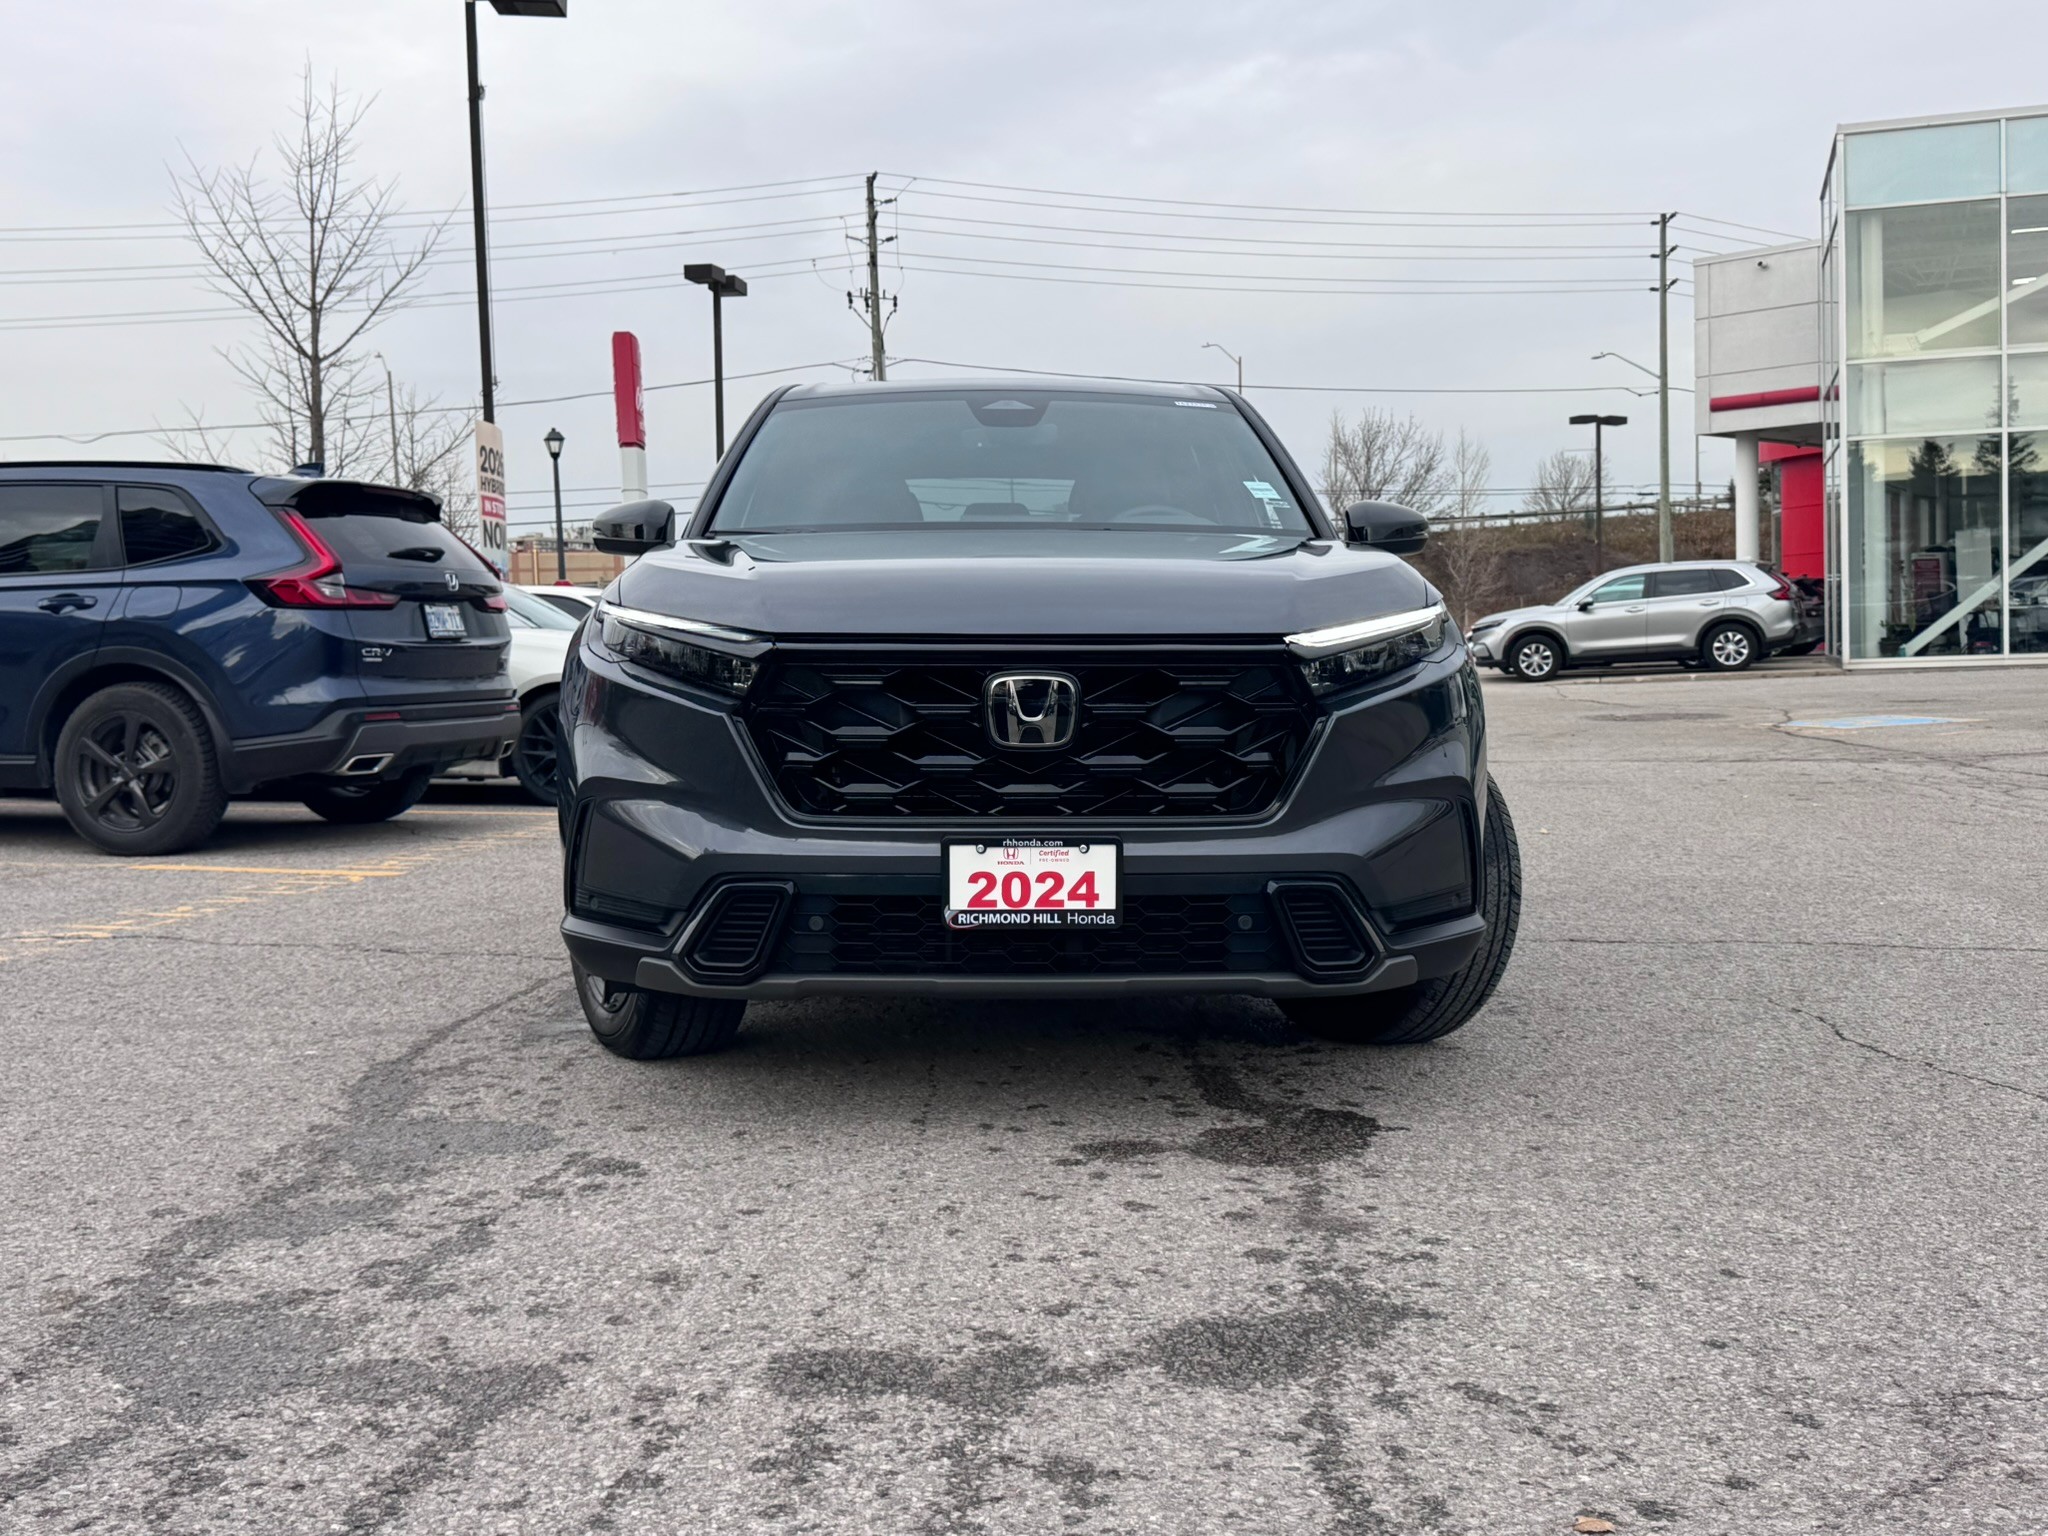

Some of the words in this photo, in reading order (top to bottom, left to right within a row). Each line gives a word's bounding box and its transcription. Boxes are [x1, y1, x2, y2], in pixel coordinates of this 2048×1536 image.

[1002, 838, 1064, 847] rhhonda.com
[1039, 849, 1070, 858] Certified
[967, 871, 1100, 909] 2024
[958, 913, 1031, 924] RICHMOND
[1033, 913, 1061, 924] HILL
[1067, 912, 1116, 925] Honda
